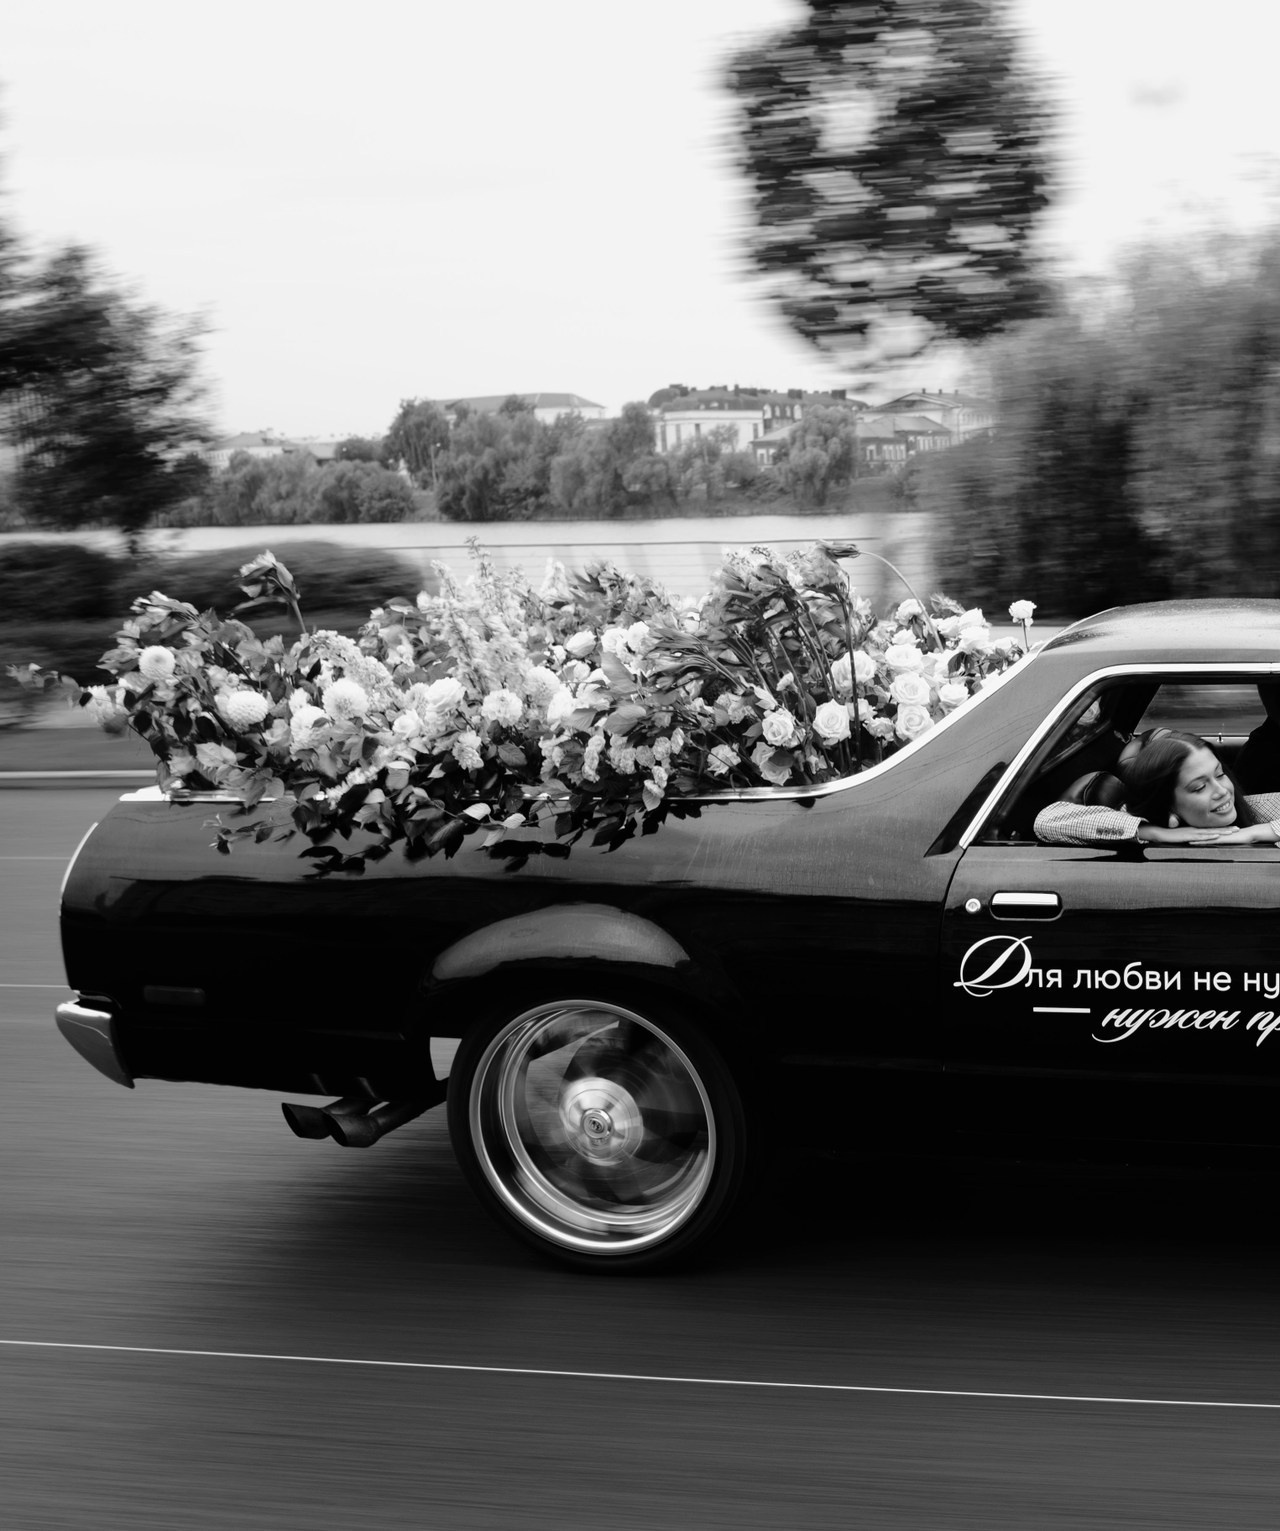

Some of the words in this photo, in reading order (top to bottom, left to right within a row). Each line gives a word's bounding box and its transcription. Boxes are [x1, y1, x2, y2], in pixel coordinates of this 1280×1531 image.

[952, 934, 1064, 998] Для
[1072, 961, 1182, 992] любви
[1193, 971, 1232, 992] не
[1091, 1008, 1242, 1043] нужен
